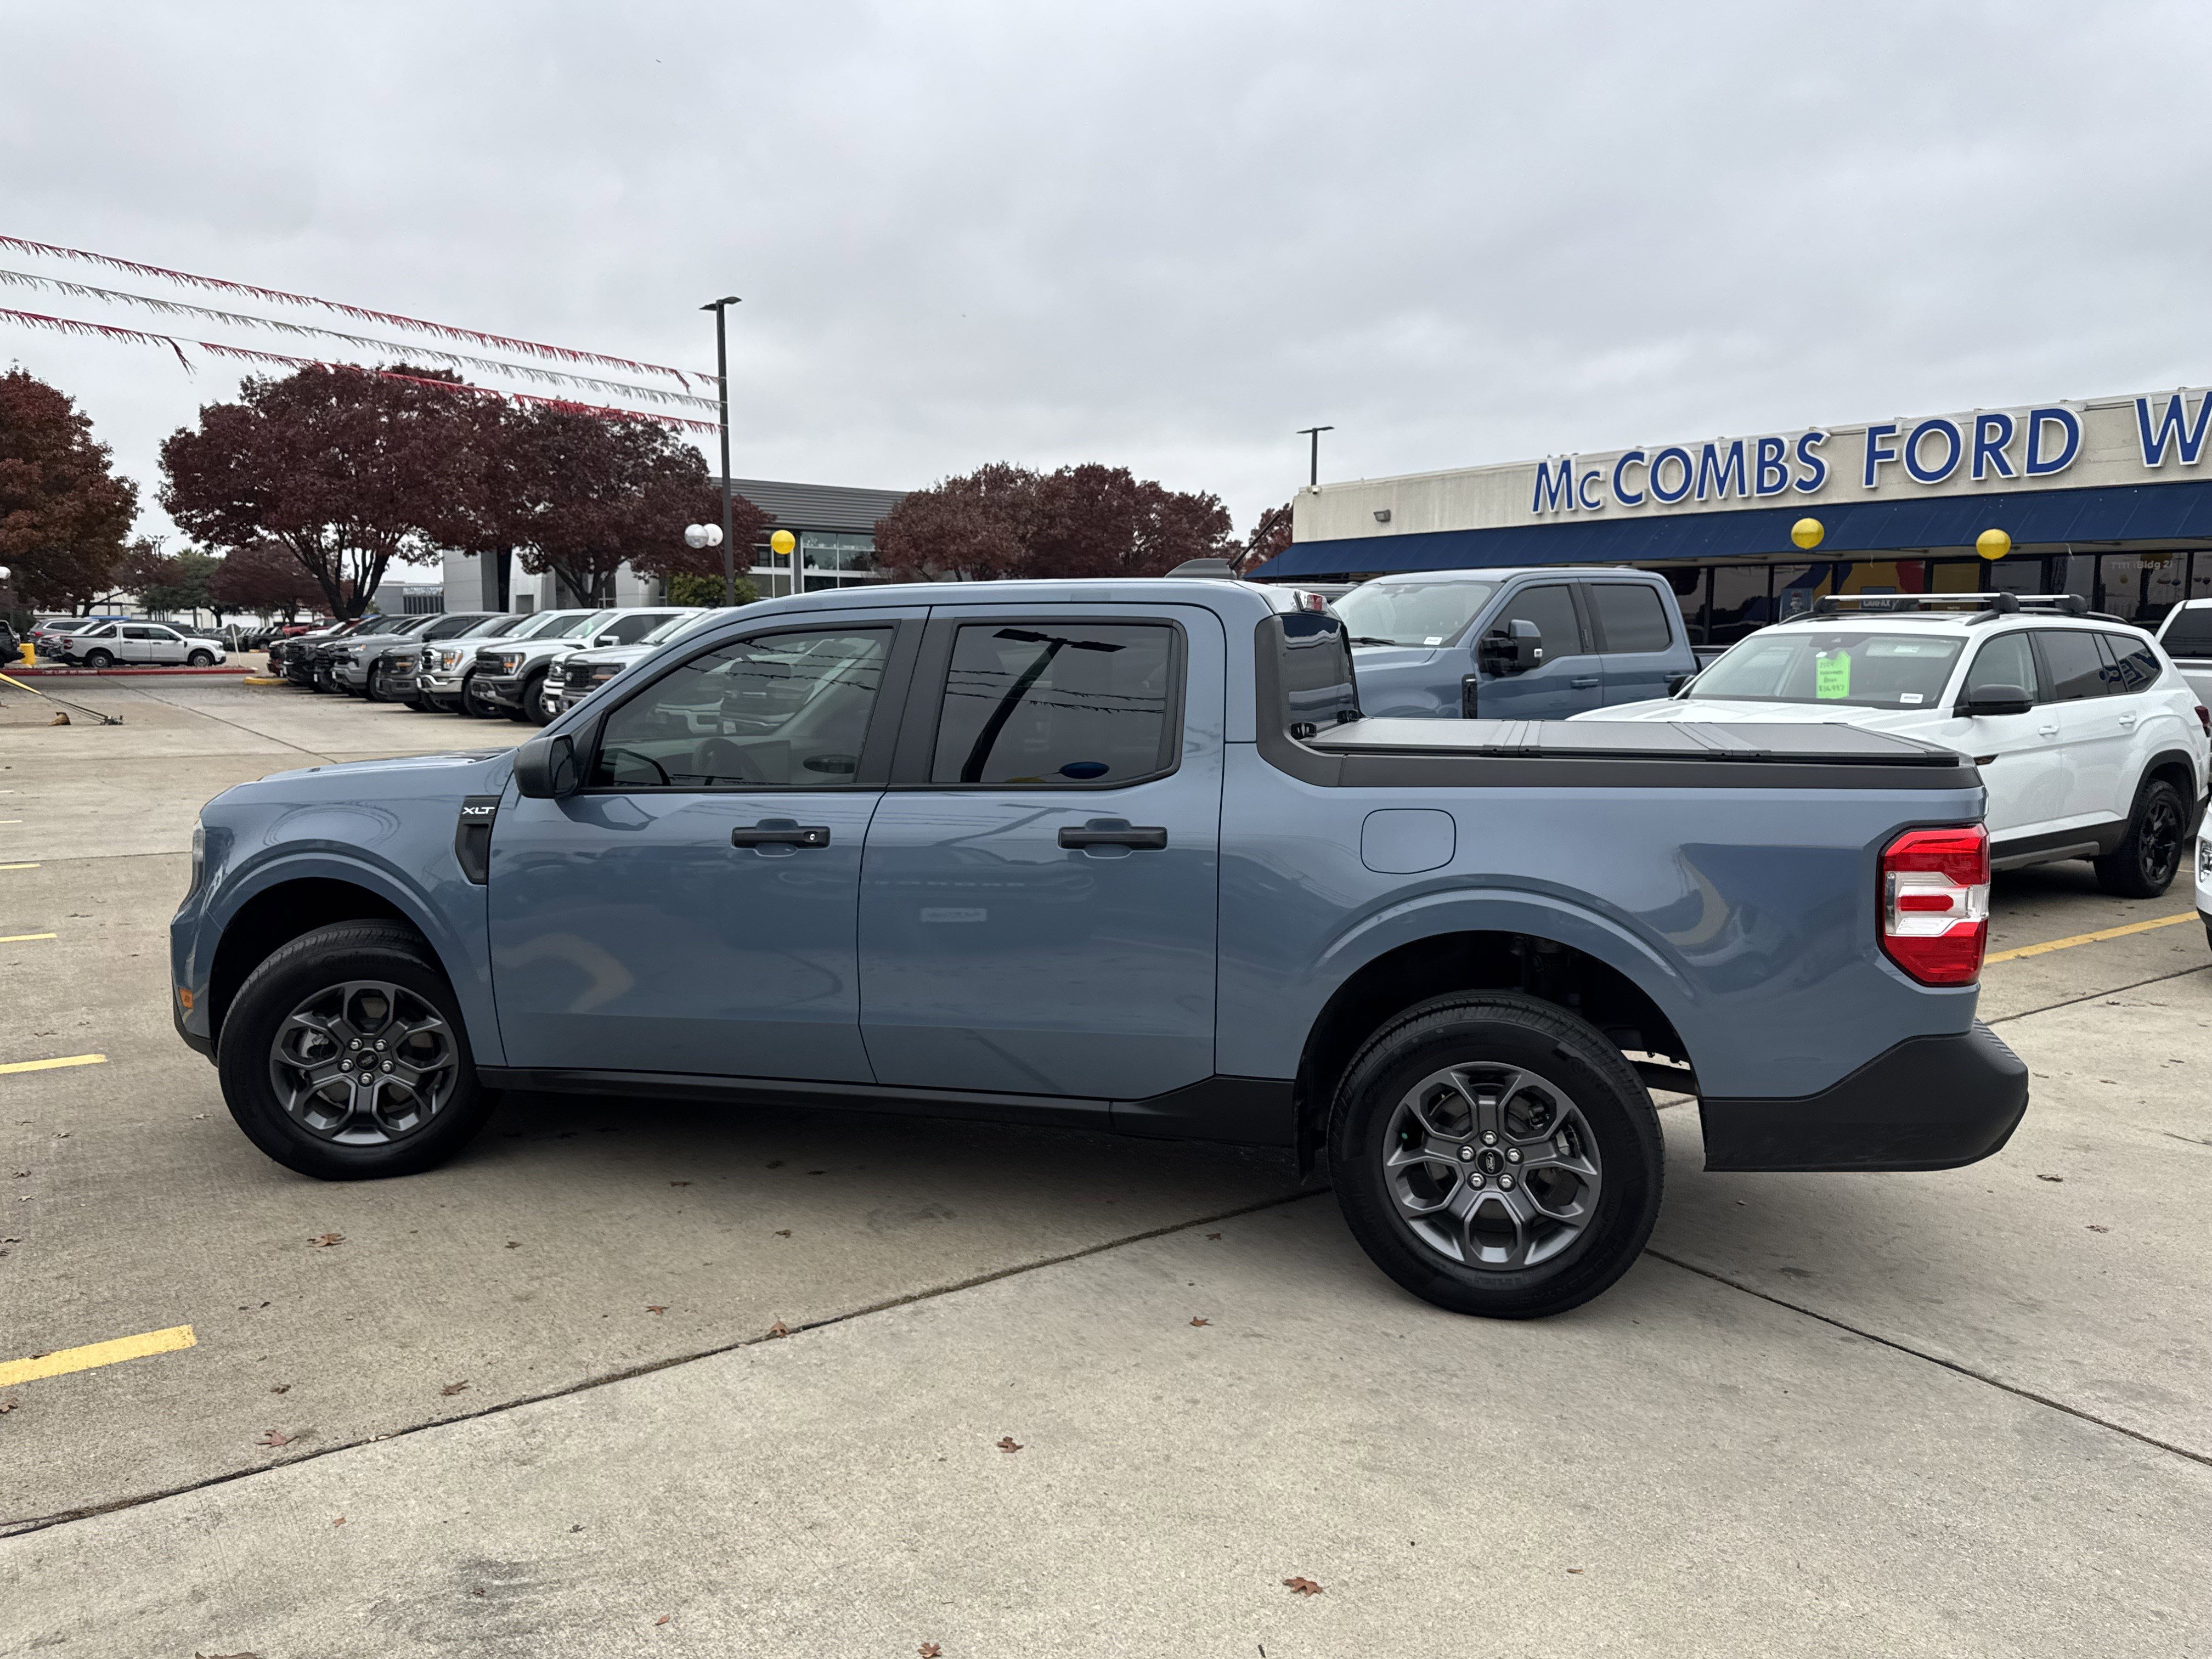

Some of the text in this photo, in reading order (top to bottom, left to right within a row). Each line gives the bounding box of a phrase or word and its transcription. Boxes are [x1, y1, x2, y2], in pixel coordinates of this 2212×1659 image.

[1532, 432, 1831, 514] McCOMBS
[1863, 406, 2084, 488] FORD
[462, 806, 495, 815] XLT
